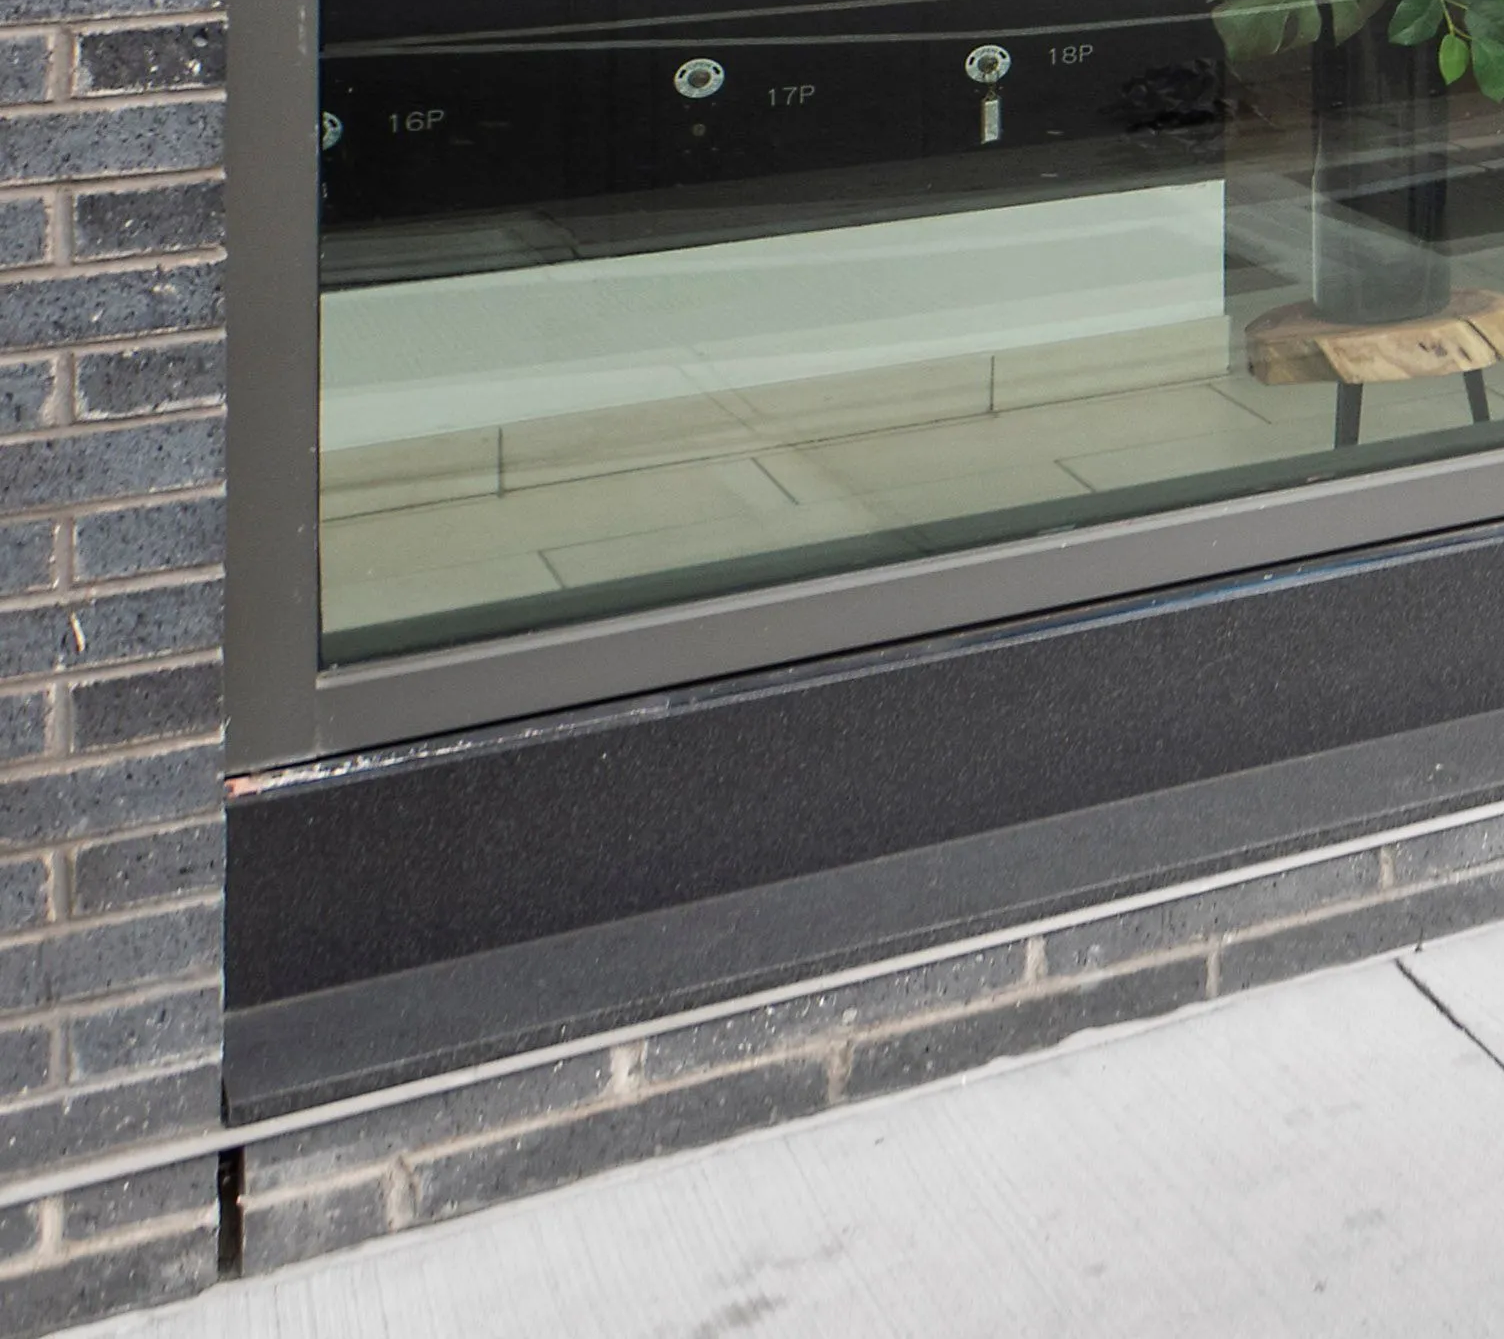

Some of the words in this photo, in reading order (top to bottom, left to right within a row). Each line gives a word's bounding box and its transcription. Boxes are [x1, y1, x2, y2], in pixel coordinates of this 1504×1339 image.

[1049, 44, 1094, 65] 18P
[768, 84, 816, 106] 17P
[389, 109, 445, 133] 16P
